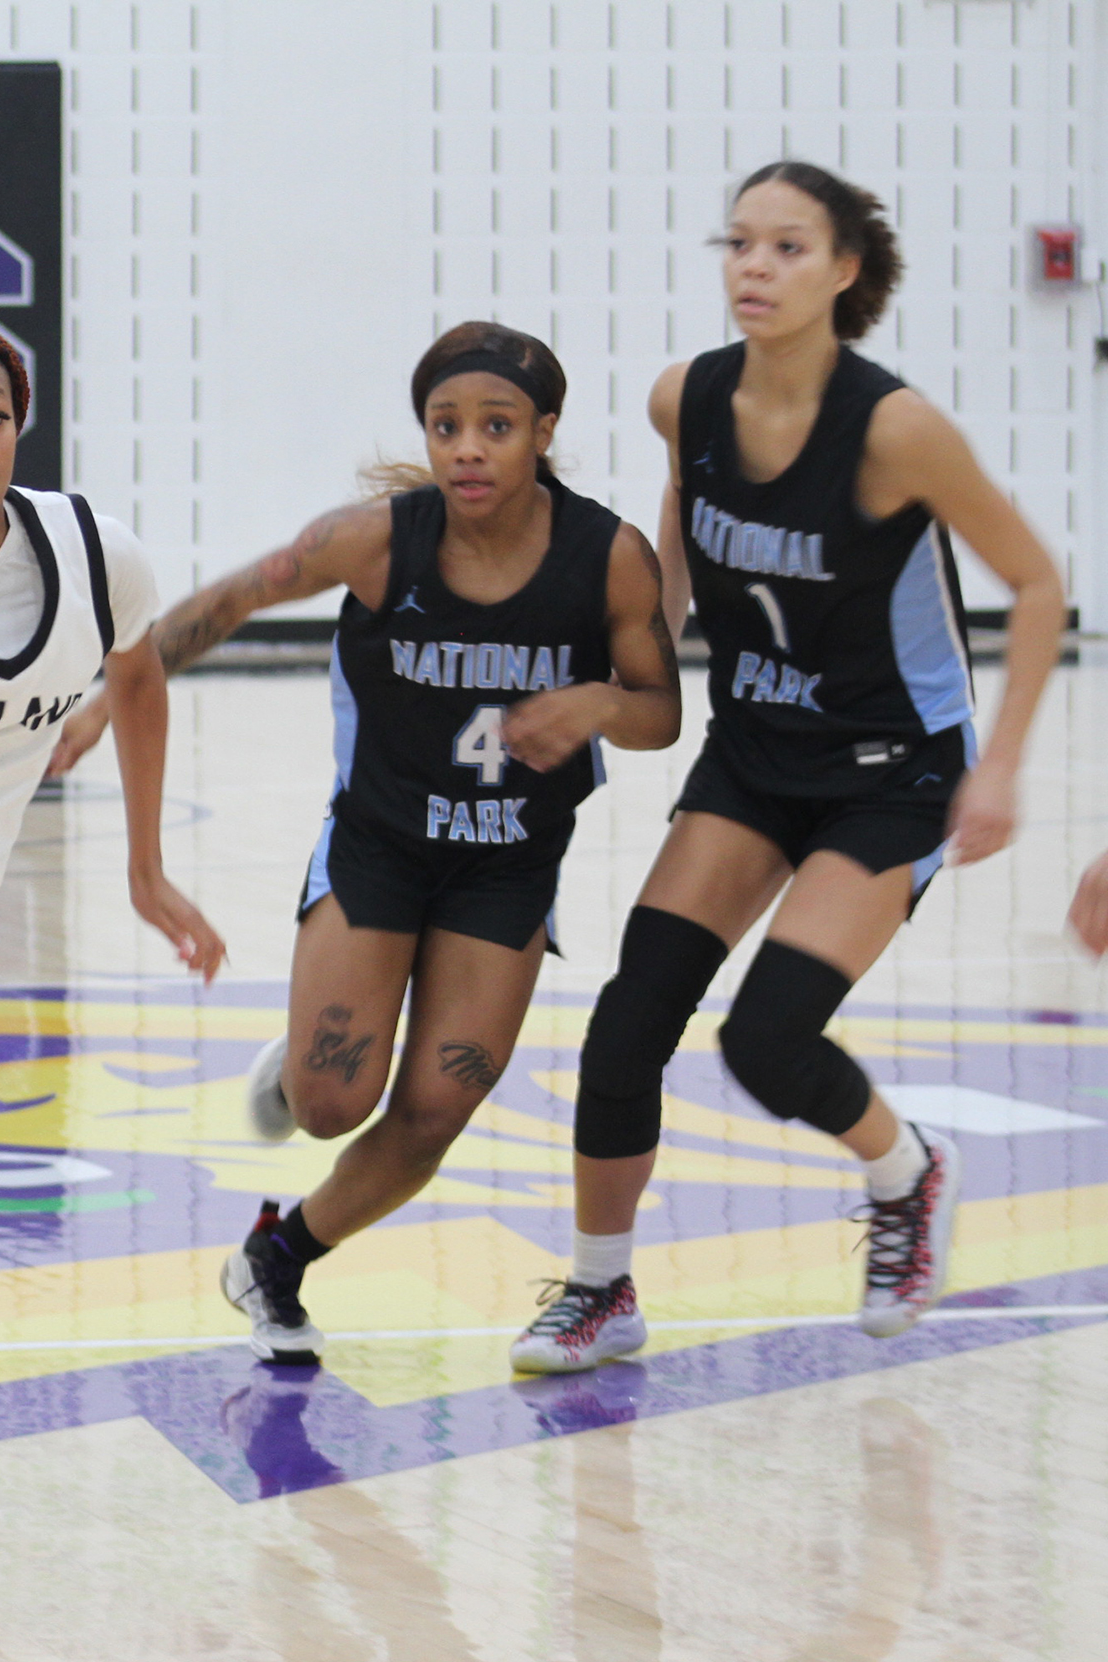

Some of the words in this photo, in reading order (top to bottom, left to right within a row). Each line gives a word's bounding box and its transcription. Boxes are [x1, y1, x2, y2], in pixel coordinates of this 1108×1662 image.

[746, 582, 790, 653] 1
[390, 639, 575, 690] NATIONAL
[731, 651, 823, 713] PARK
[451, 703, 510, 787] 4
[427, 794, 528, 844] PARK
